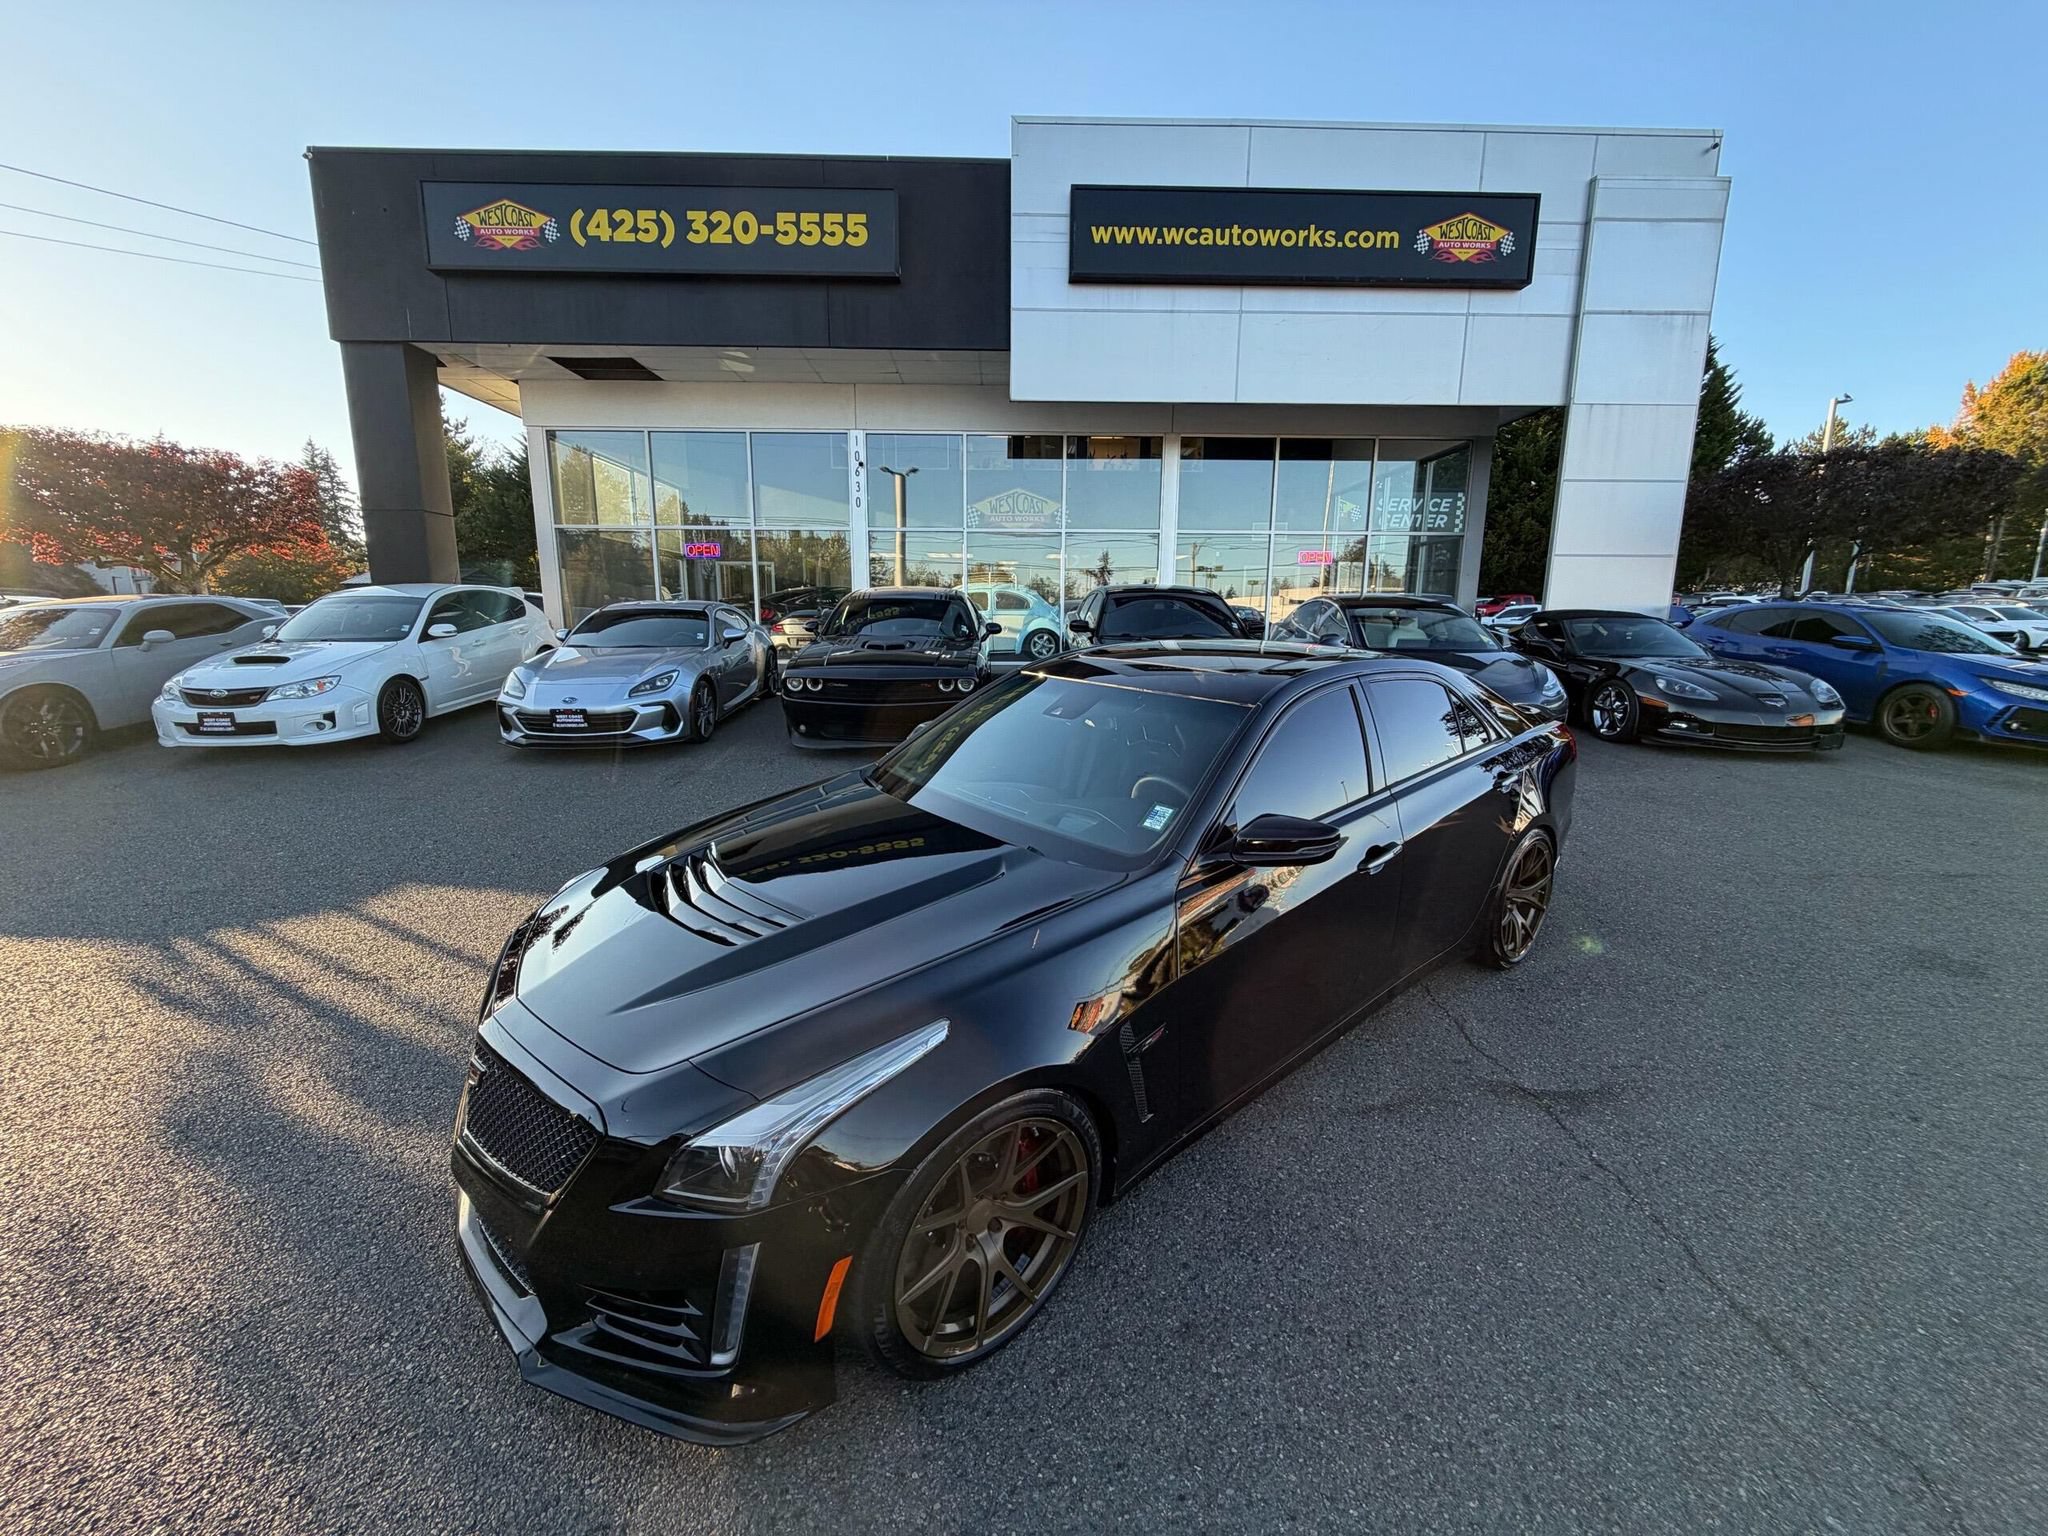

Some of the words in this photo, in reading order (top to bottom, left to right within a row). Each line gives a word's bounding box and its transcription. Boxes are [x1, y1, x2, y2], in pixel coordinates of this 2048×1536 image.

[570, 208, 675, 248] (425)
[686, 210, 868, 247] 320-5555
[1091, 225, 1400, 248] www.wcautoworks.com
[854, 435, 862, 508] 10630
[1376, 498, 1453, 512] SERVCE
[687, 545, 719, 556] OPEN
